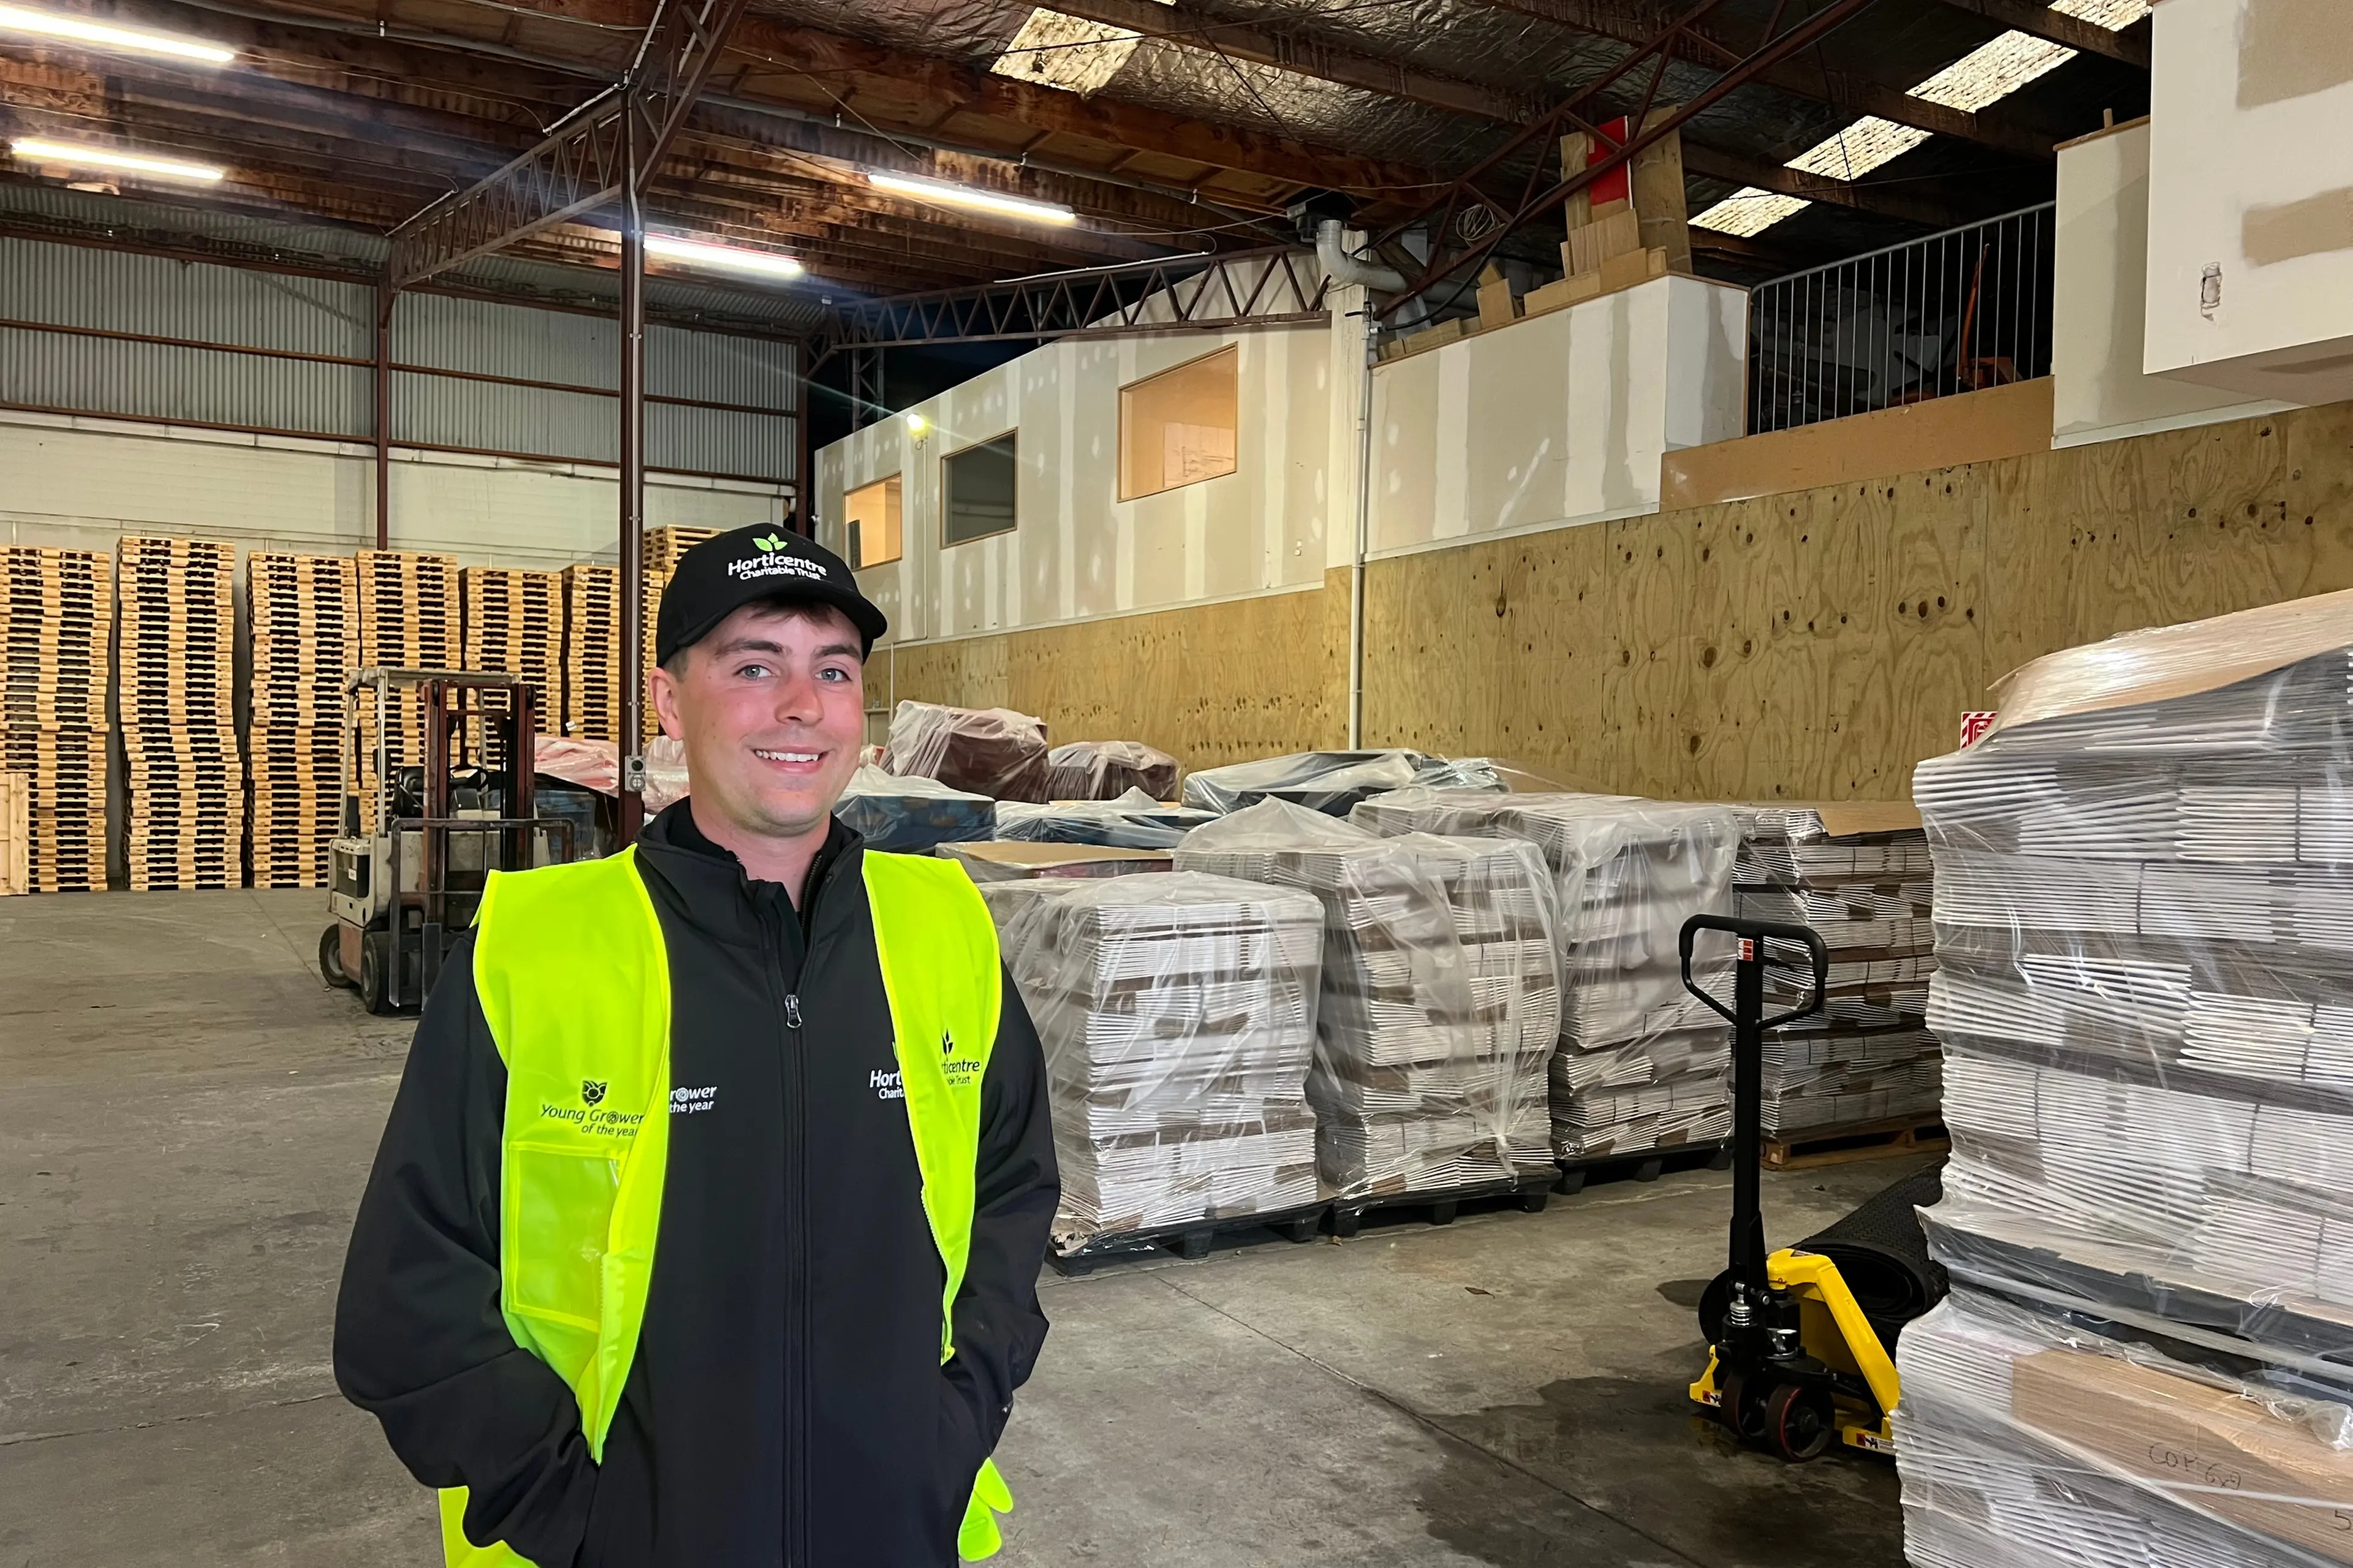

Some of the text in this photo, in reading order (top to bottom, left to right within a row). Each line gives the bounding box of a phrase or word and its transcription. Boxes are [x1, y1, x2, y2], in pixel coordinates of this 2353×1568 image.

[728, 551, 827, 576] Horticentre
[740, 565, 821, 581] Charitable Trust
[956, 1075, 971, 1085] Trust
[541, 1104, 645, 1125] Young Grower
[669, 1100, 714, 1115] the year
[582, 1123, 596, 1134] of
[597, 1123, 615, 1135] the
